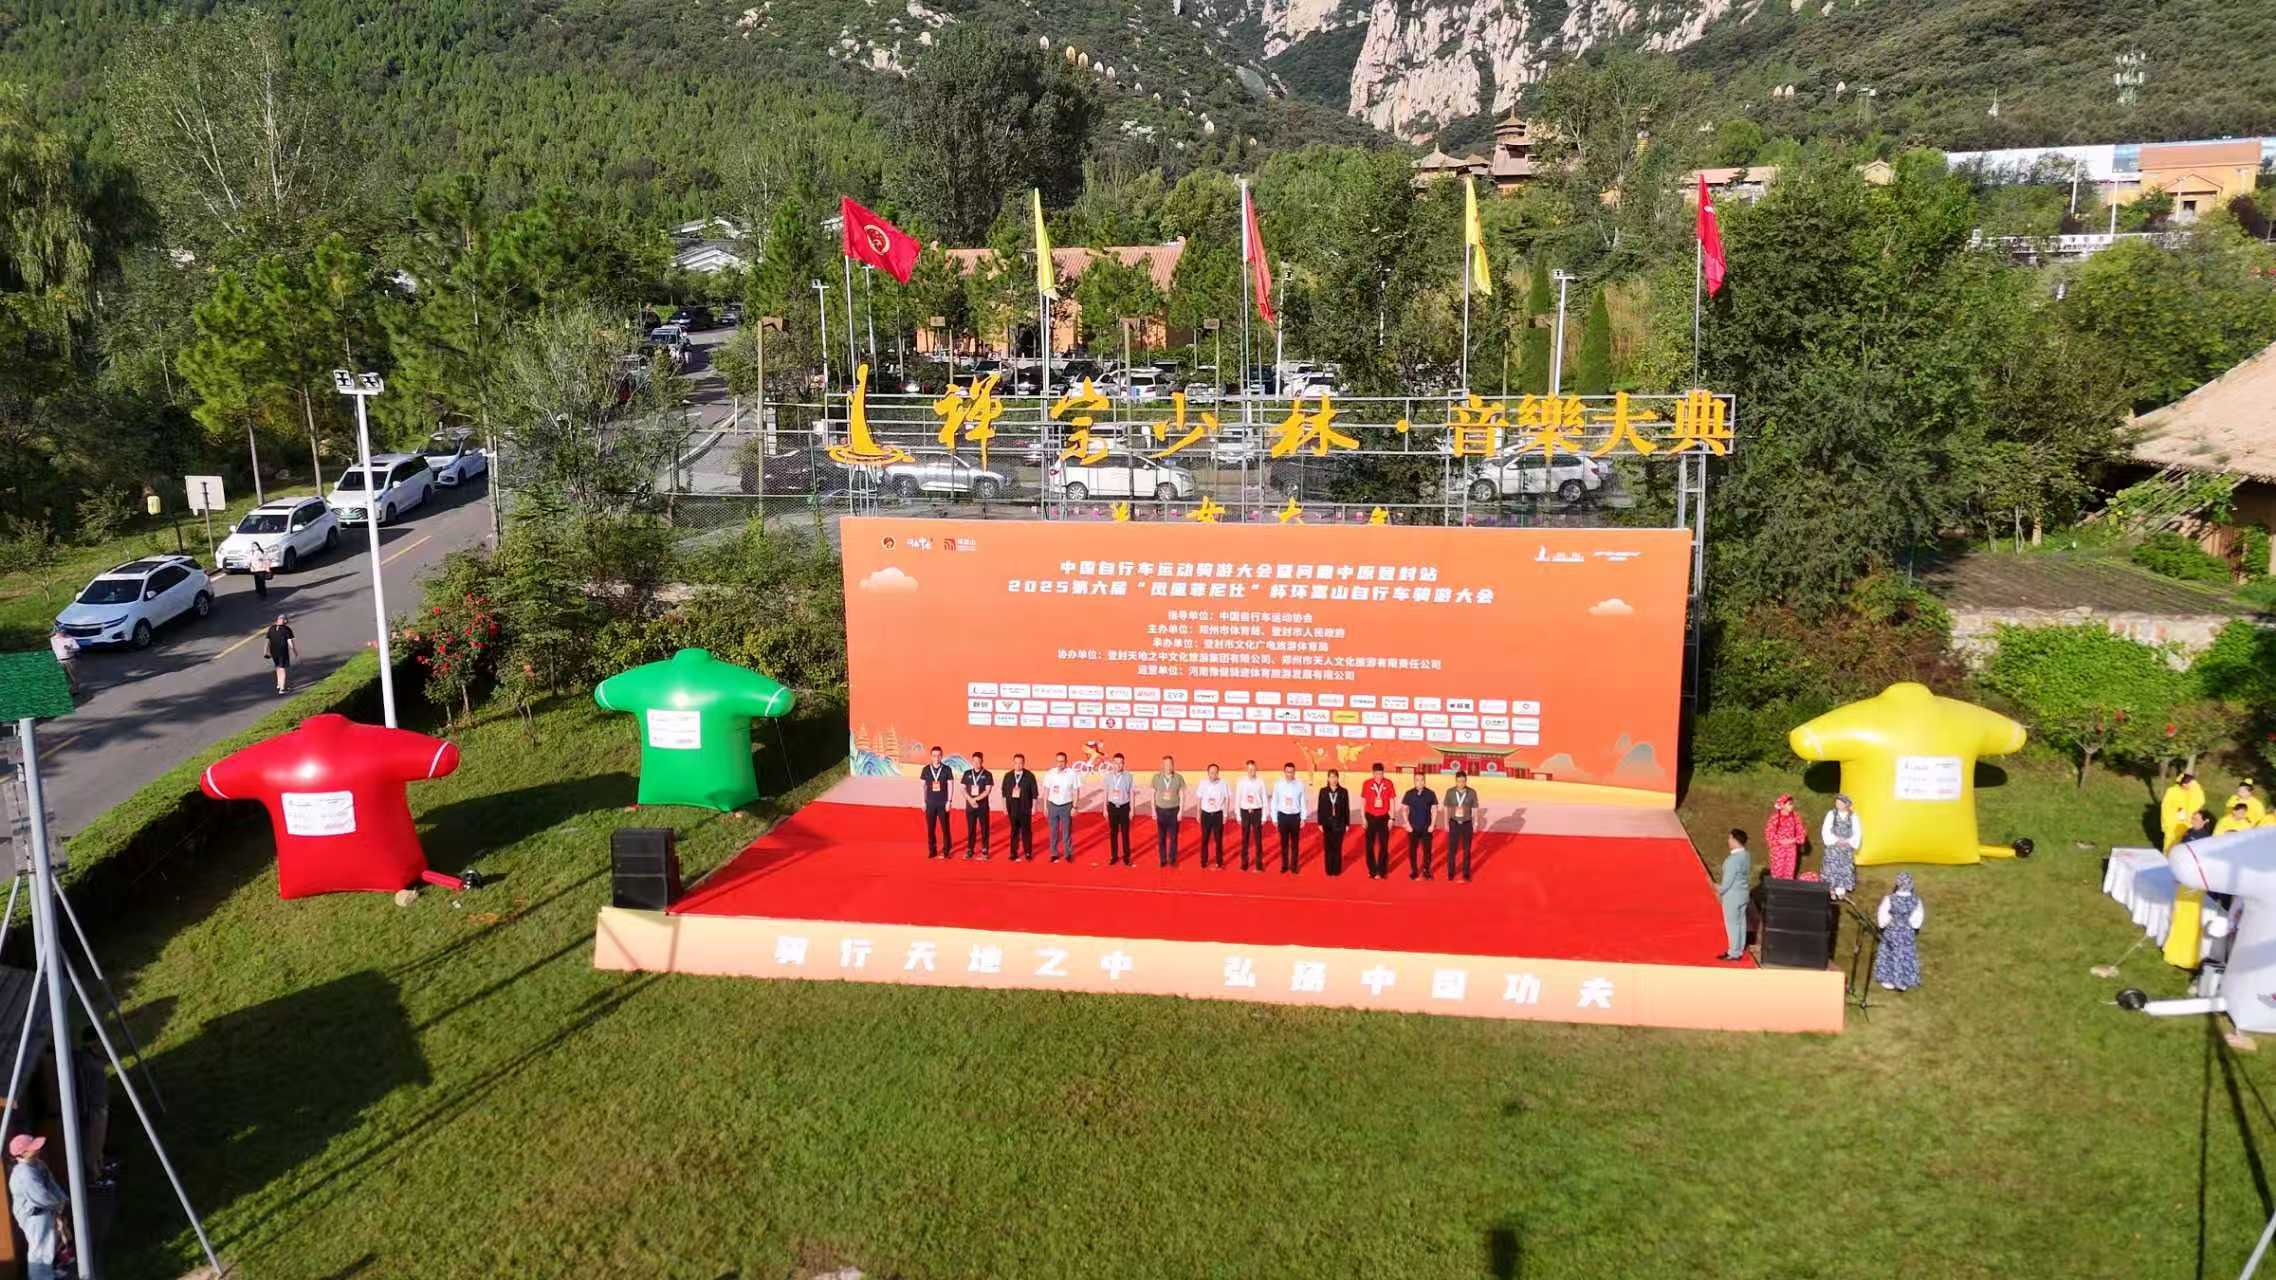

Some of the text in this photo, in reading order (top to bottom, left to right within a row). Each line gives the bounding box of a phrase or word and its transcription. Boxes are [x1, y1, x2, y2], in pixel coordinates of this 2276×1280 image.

[774, 935, 1614, 1009] 骑行天地之中 弘扬中国功夫
